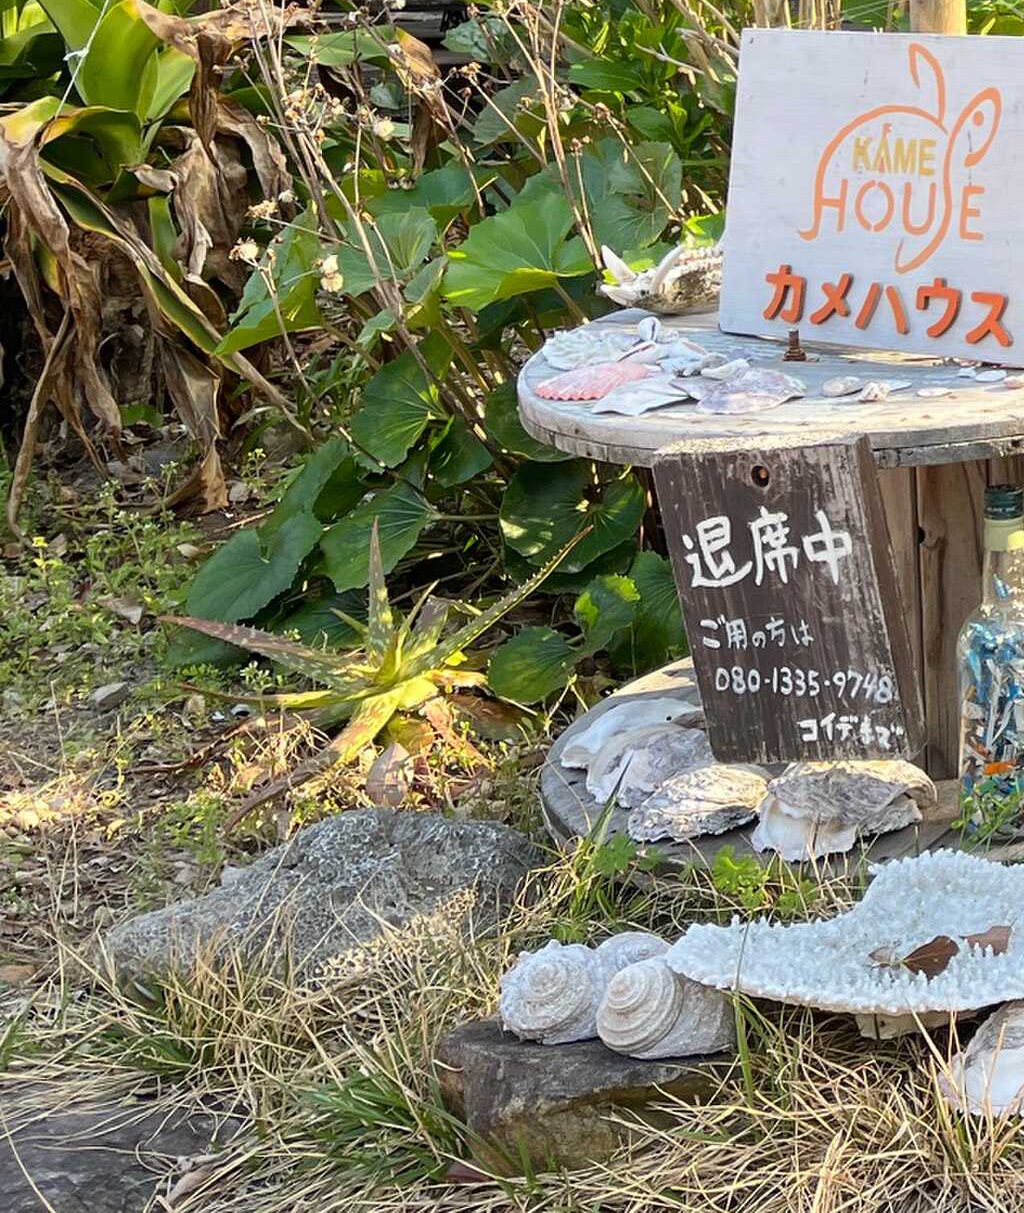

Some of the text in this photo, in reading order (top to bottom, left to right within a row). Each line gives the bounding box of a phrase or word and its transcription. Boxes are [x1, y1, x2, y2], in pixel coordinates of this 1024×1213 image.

[852, 128, 938, 177] KAME
[800, 175, 986, 271] HOUSE
[763, 264, 1014, 348] カメハウス
[681, 505, 853, 588] 退席中
[700, 614, 815, 652] ご用の方は
